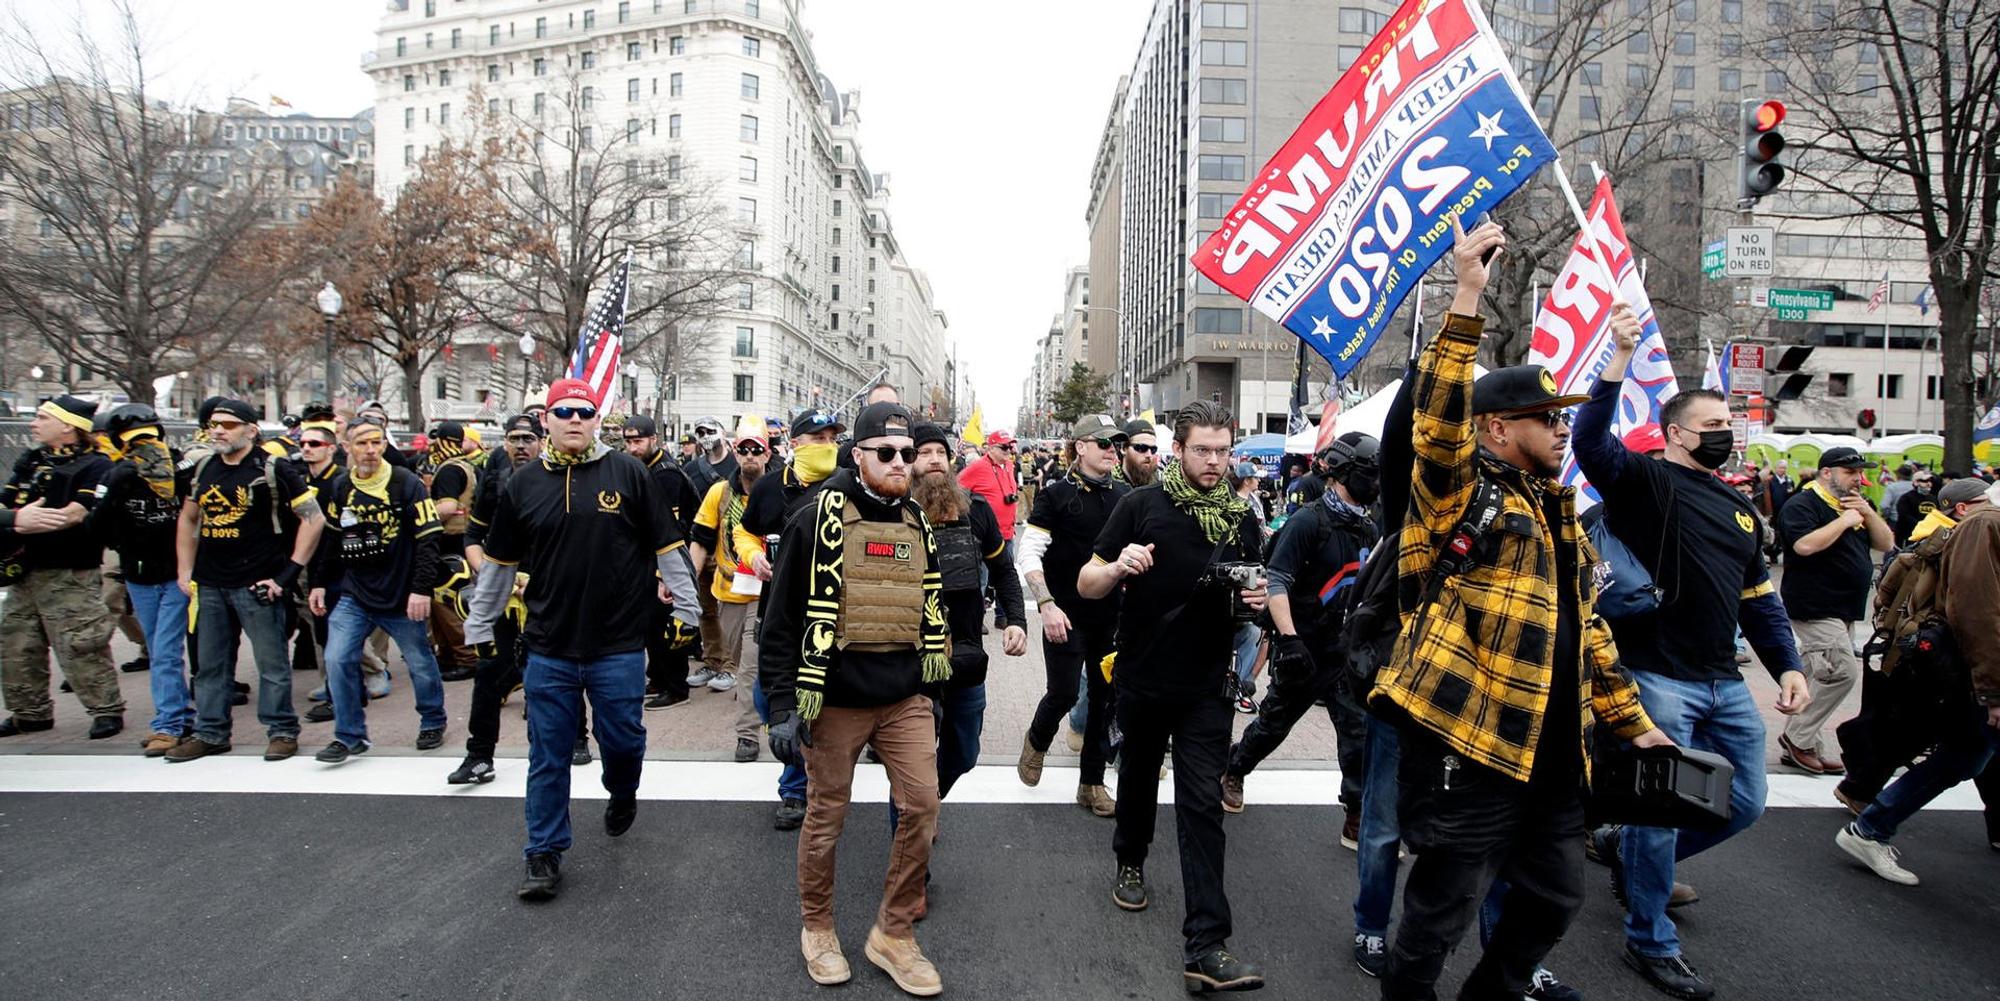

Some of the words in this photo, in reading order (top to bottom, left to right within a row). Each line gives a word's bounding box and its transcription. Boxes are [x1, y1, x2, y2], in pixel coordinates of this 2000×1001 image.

[1741, 234, 1760, 244] NO
[1736, 247, 1766, 257] TURN
[1730, 260, 1744, 270] ON
[1750, 260, 1771, 270] RED
[1769, 290, 1820, 308] Pennsylvania
[1781, 309, 1804, 320] 1300
[1212, 340, 1230, 350] JW
[1238, 340, 1297, 351] MARRIO
[211, 528, 239, 538] BOYS
[866, 542, 895, 555] RWDS
